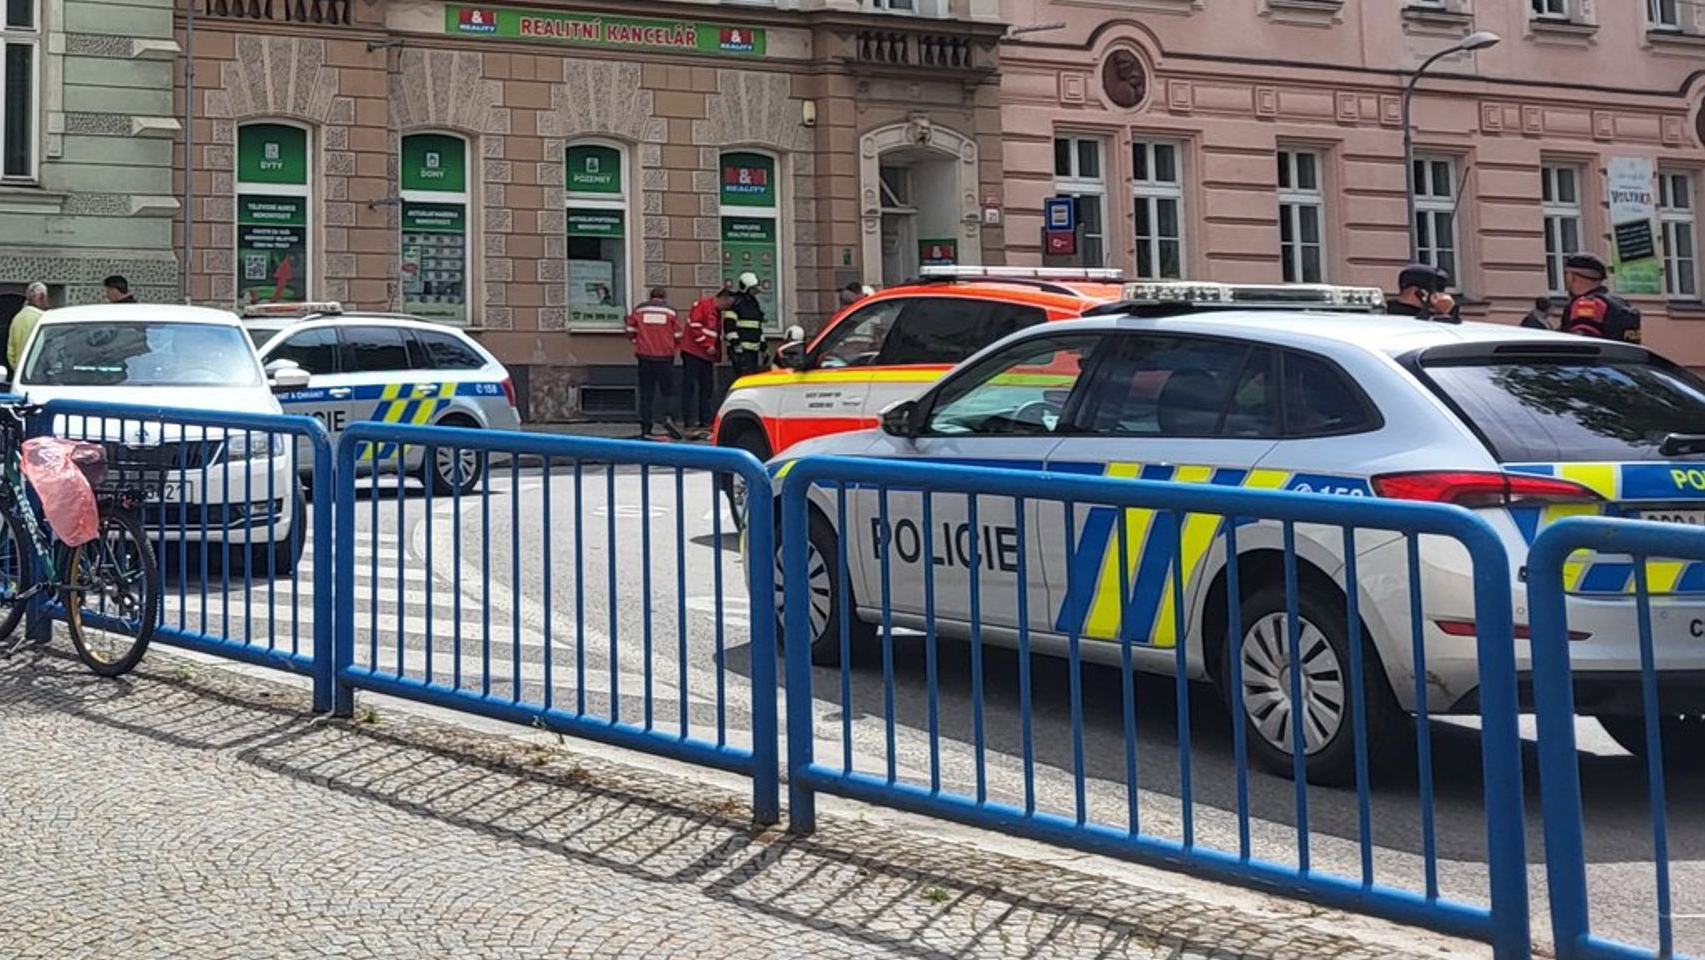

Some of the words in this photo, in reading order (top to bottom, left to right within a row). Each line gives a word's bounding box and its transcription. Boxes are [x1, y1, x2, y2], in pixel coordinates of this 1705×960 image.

[520, 16, 602, 41] REALITNÍ
[606, 24, 699, 47] KANCELÁŘ
[421, 169, 444, 178] DOMY
[1670, 468, 1705, 490] PO
